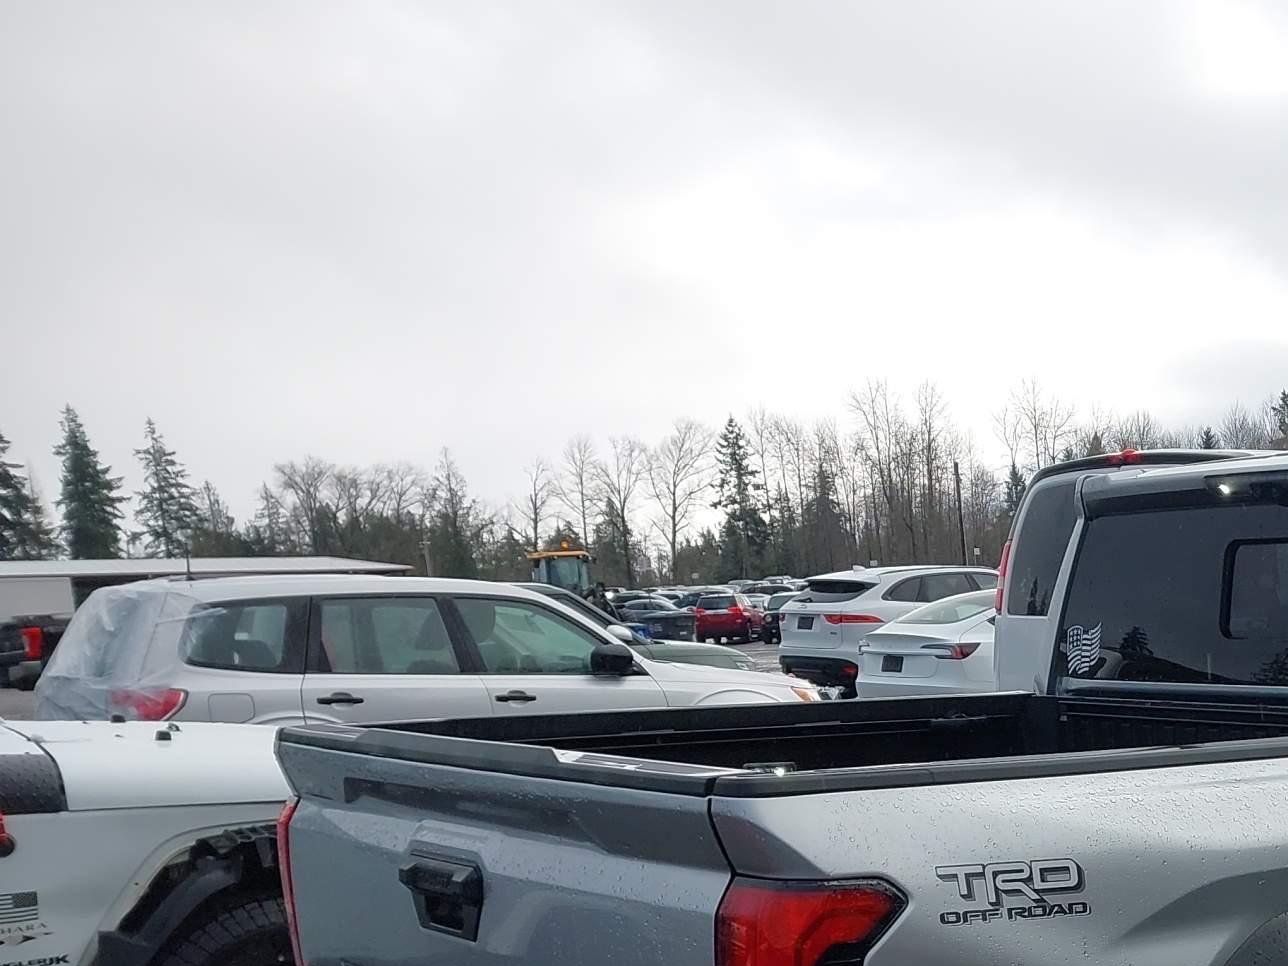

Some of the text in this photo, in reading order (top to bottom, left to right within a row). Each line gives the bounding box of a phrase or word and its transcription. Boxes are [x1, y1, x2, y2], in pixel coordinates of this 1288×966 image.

[935, 858, 1086, 906] TRD
[939, 901, 1091, 925] OFF ROAD
